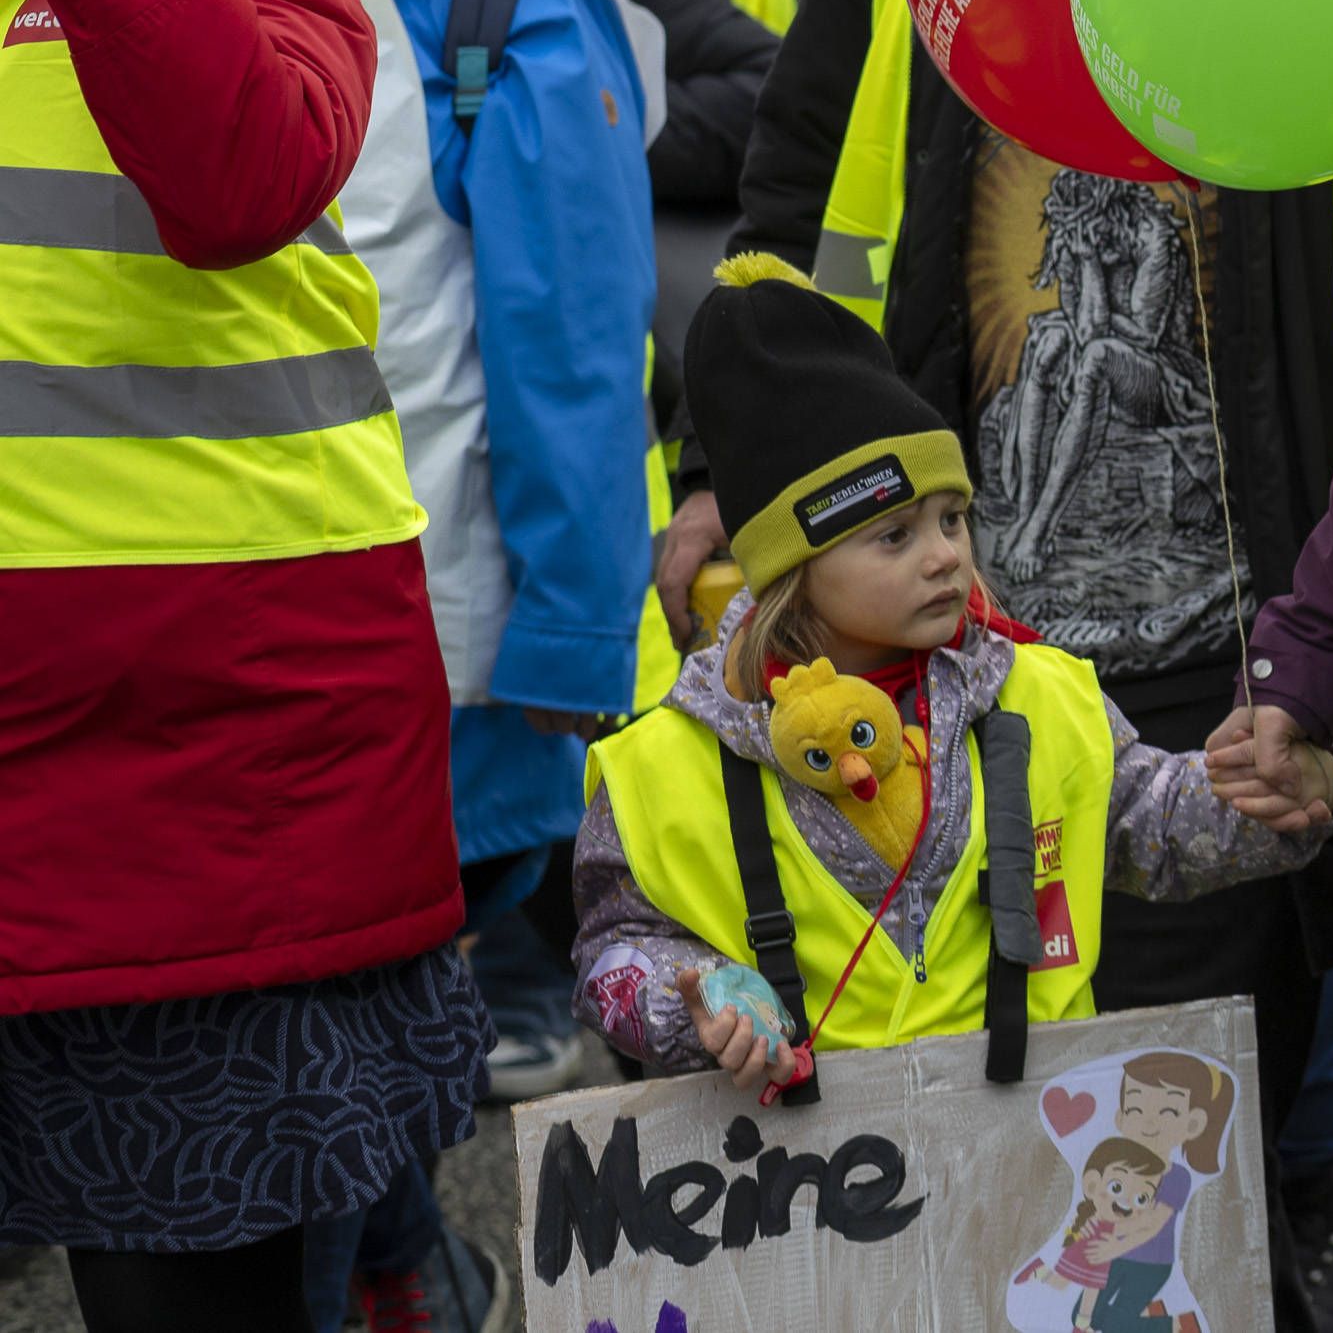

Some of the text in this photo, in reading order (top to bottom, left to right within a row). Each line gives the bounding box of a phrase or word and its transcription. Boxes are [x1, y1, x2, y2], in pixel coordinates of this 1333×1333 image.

[1094, 57, 1143, 116] ARBEIT
[1101, 42, 1139, 91] GELD
[1143, 81, 1182, 119] FÜR
[534, 1114, 931, 1287] Meine
